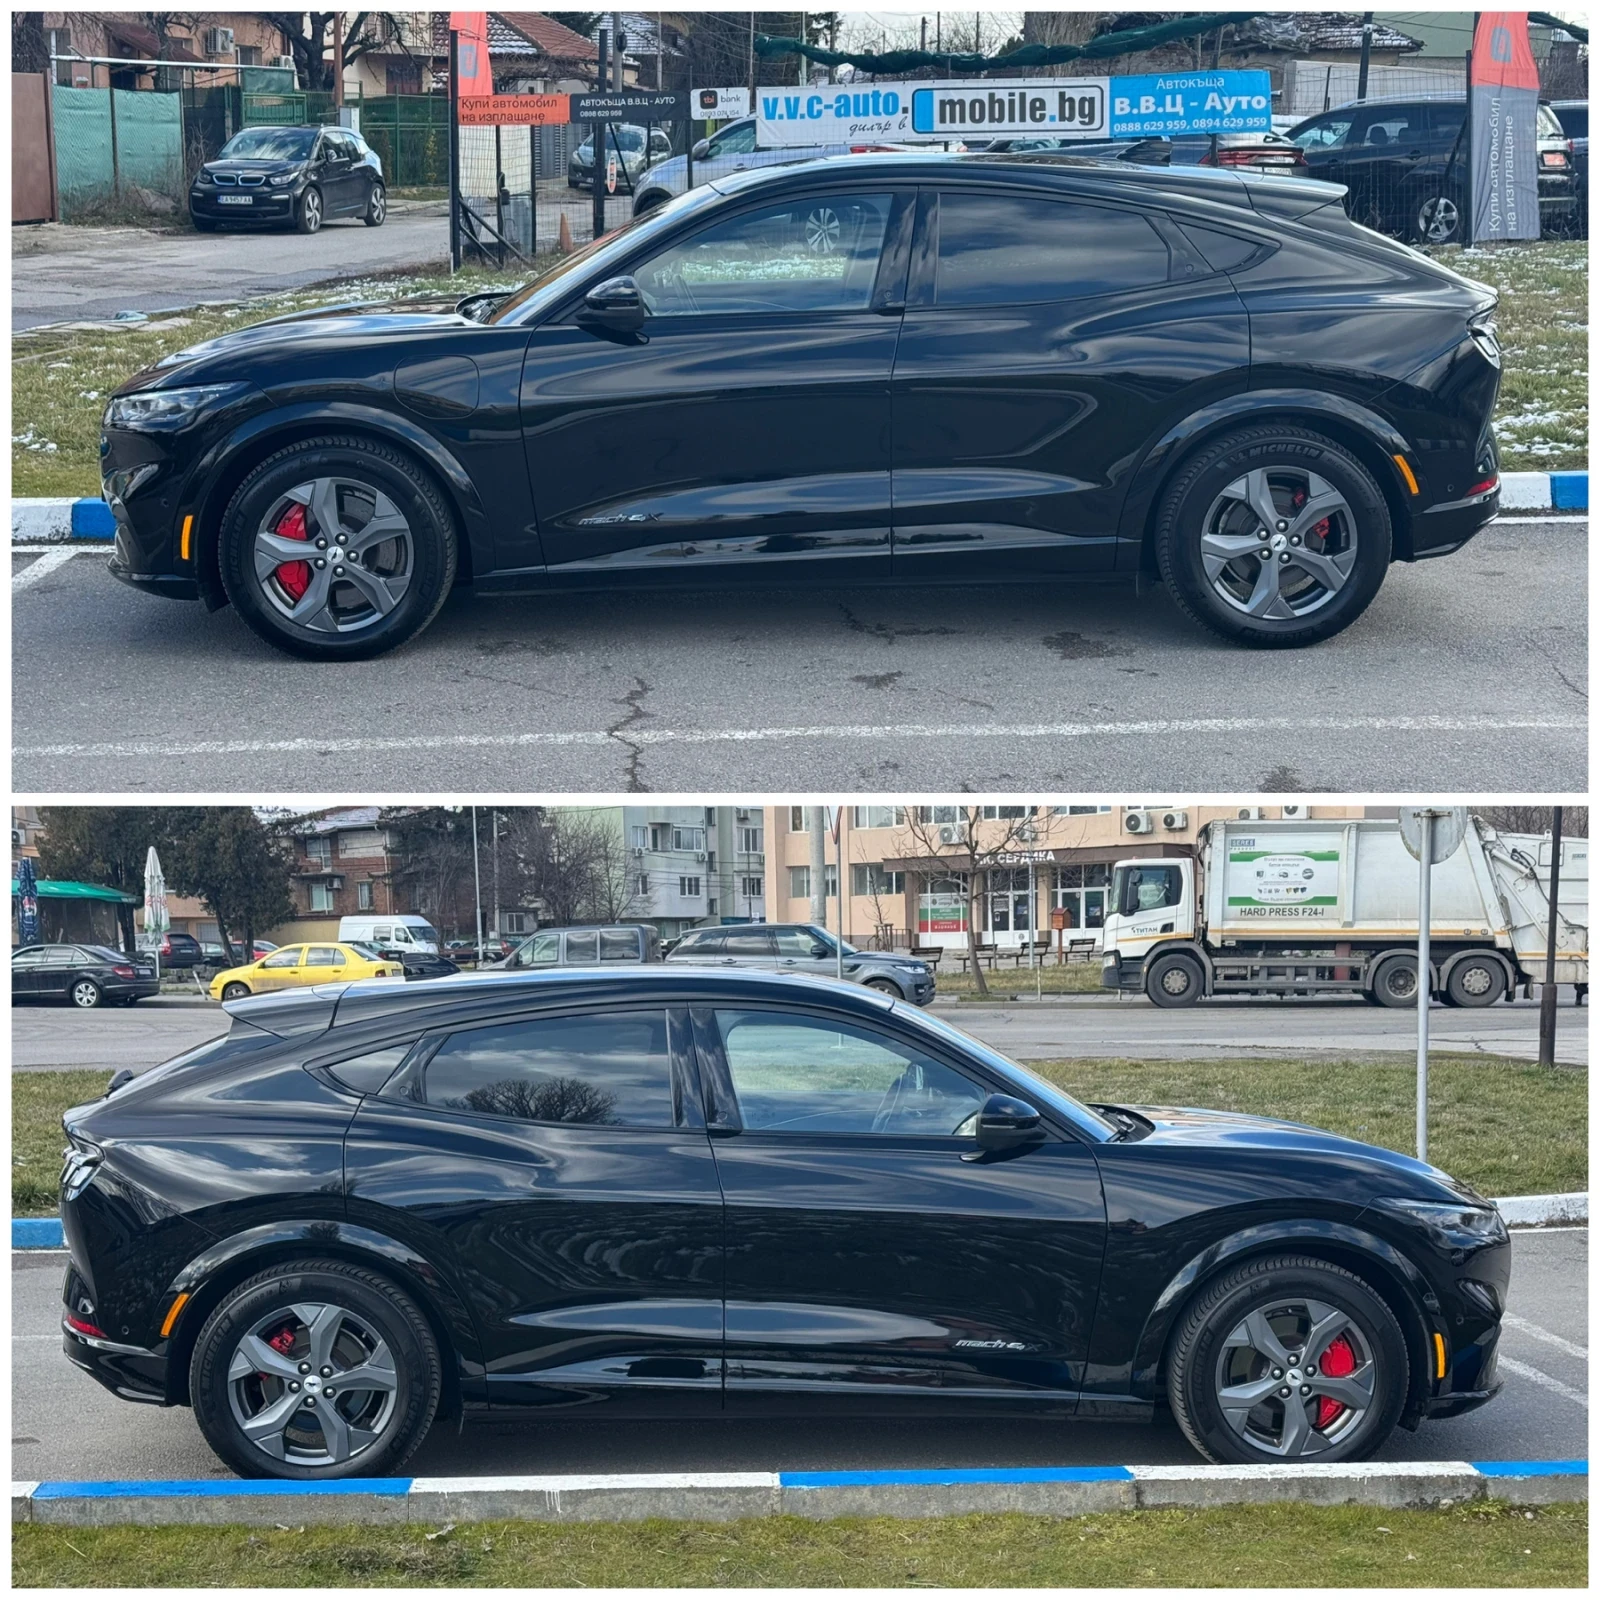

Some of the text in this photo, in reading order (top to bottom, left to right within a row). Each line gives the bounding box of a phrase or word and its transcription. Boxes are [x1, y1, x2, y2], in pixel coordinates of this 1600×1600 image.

[1155, 77, 1225, 91] Автокъща
[461, 97, 558, 111] Купи автомобил
[579, 98, 627, 107] АВТОКЪЩА
[654, 96, 676, 105] АУТО
[720, 94, 741, 103] bank
[1114, 93, 1184, 117] В.В.Ц
[1203, 91, 1267, 115] Ауто
[938, 91, 1097, 127] mobile.bg
[462, 112, 545, 123] на изплащане
[1113, 116, 1267, 133] 0888 629 959, 0894 629 959
[849, 115, 909, 137] дилър в
[1488, 97, 1502, 232] Купи автомобил
[1504, 115, 1518, 232] на изплащане
[1250, 443, 1320, 459] MICHELIN
[1240, 907, 1267, 917] HARD
[1268, 907, 1300, 917] PRESS
[1136, 926, 1158, 934] ТИТАН
